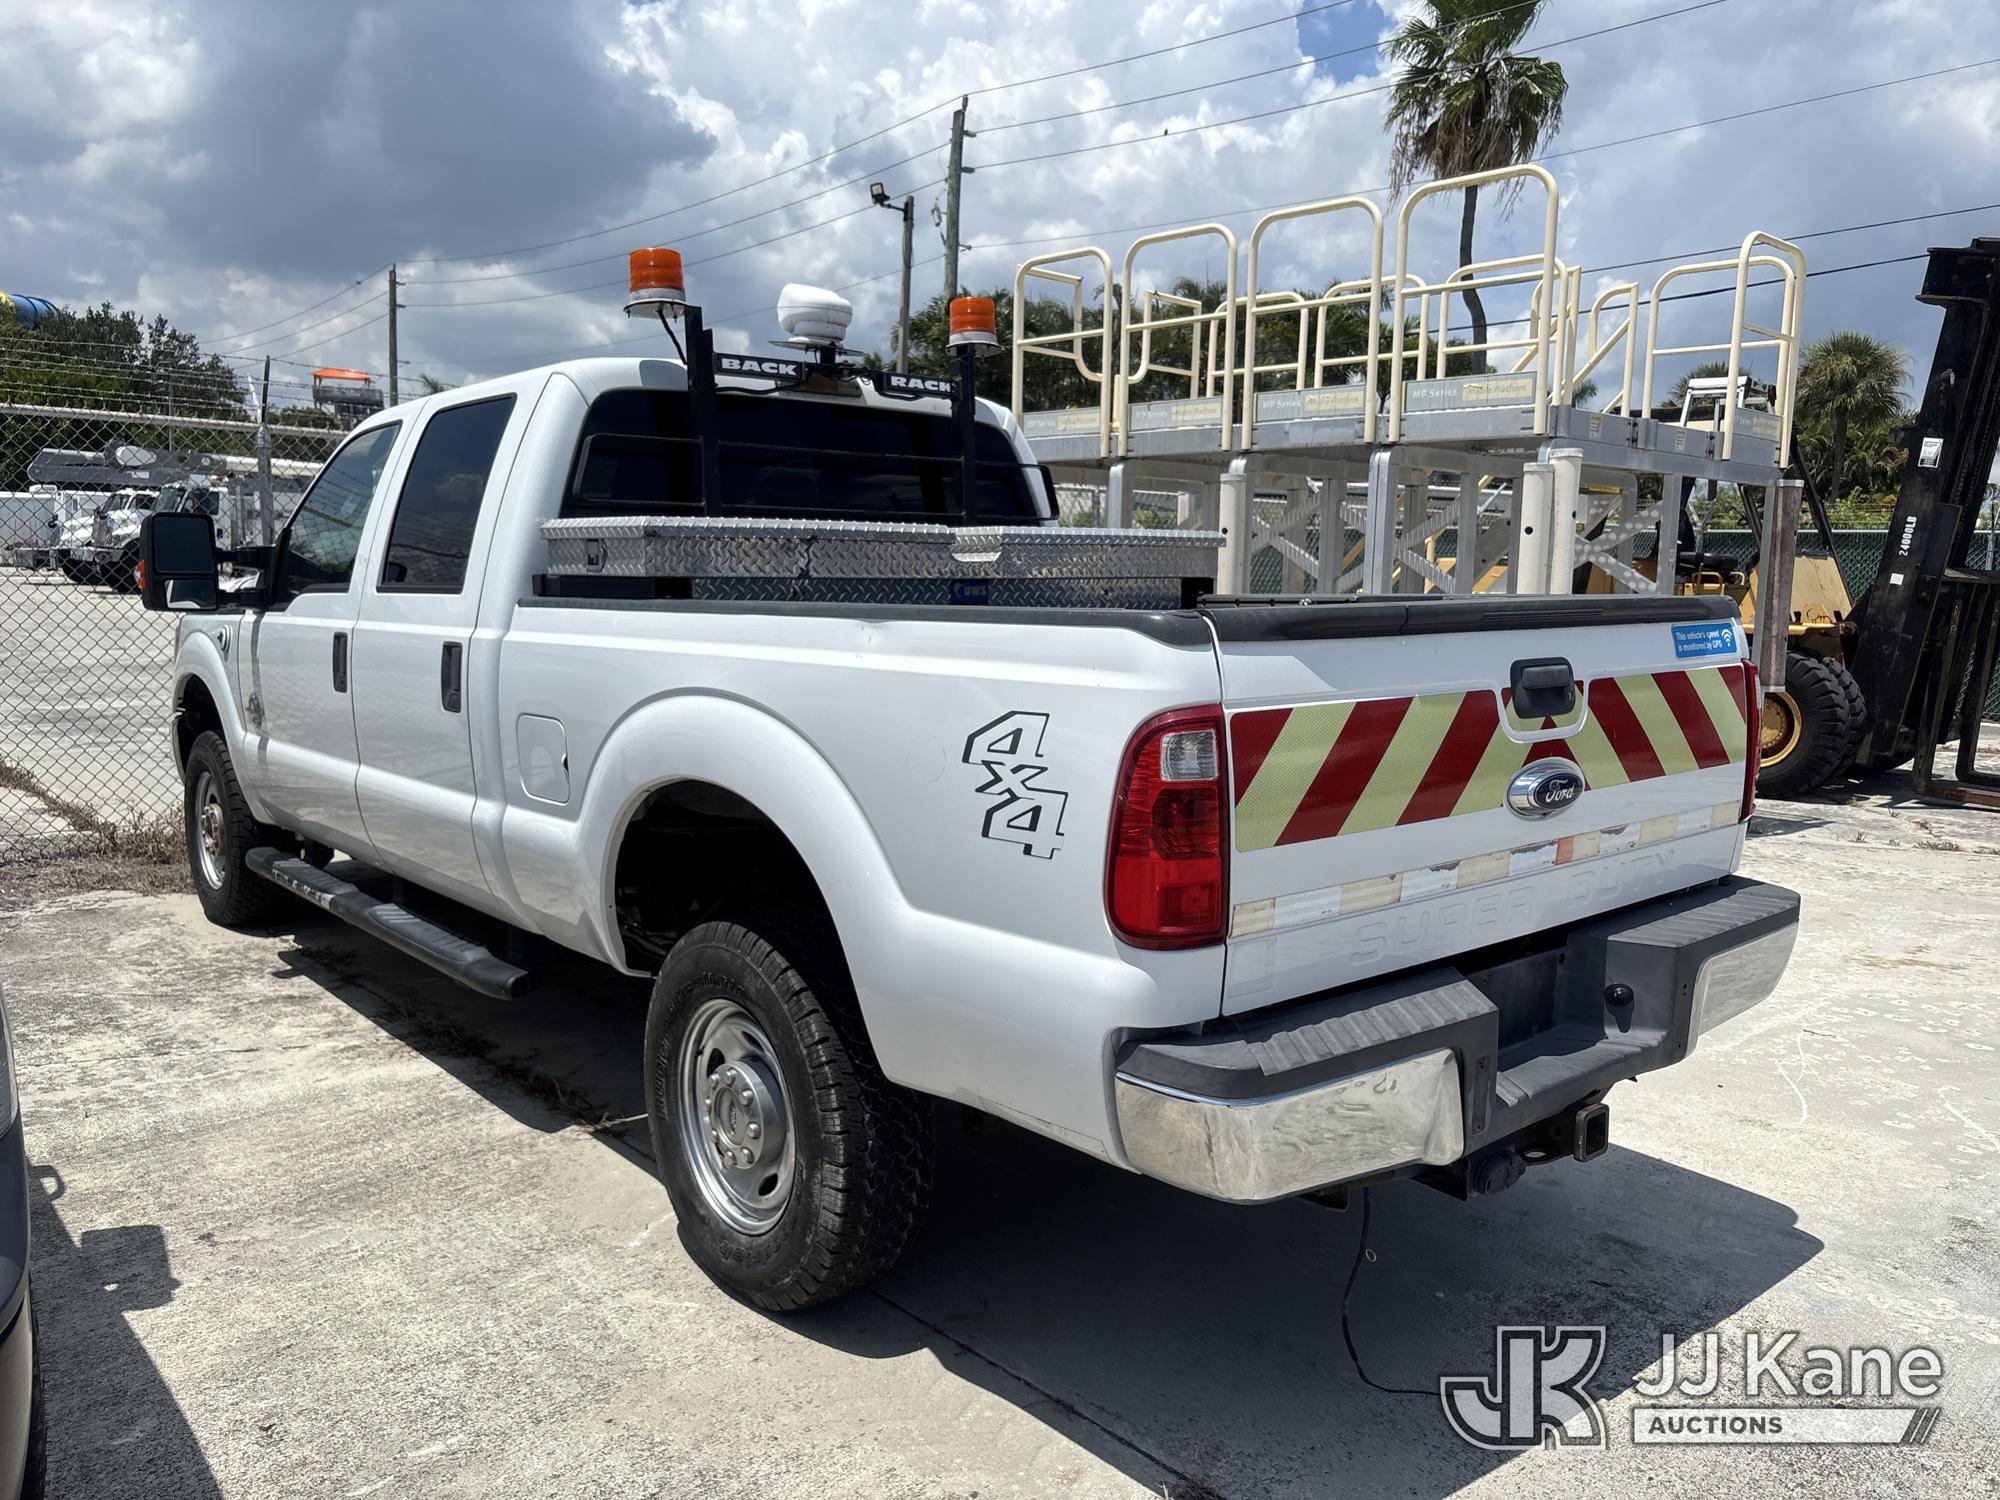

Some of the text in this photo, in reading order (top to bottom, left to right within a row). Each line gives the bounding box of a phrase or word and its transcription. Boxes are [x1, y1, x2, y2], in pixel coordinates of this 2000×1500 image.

[721, 358, 797, 376] BACK
[890, 375, 953, 392] RACK
[1898, 515, 1918, 557] 24000LB
[1676, 631, 1687, 640] This
[1683, 641, 1706, 652] monitored
[1712, 639, 1723, 649] GPS
[1545, 779, 1575, 803] Ford
[1351, 848, 1676, 967] SUPER DUTY
